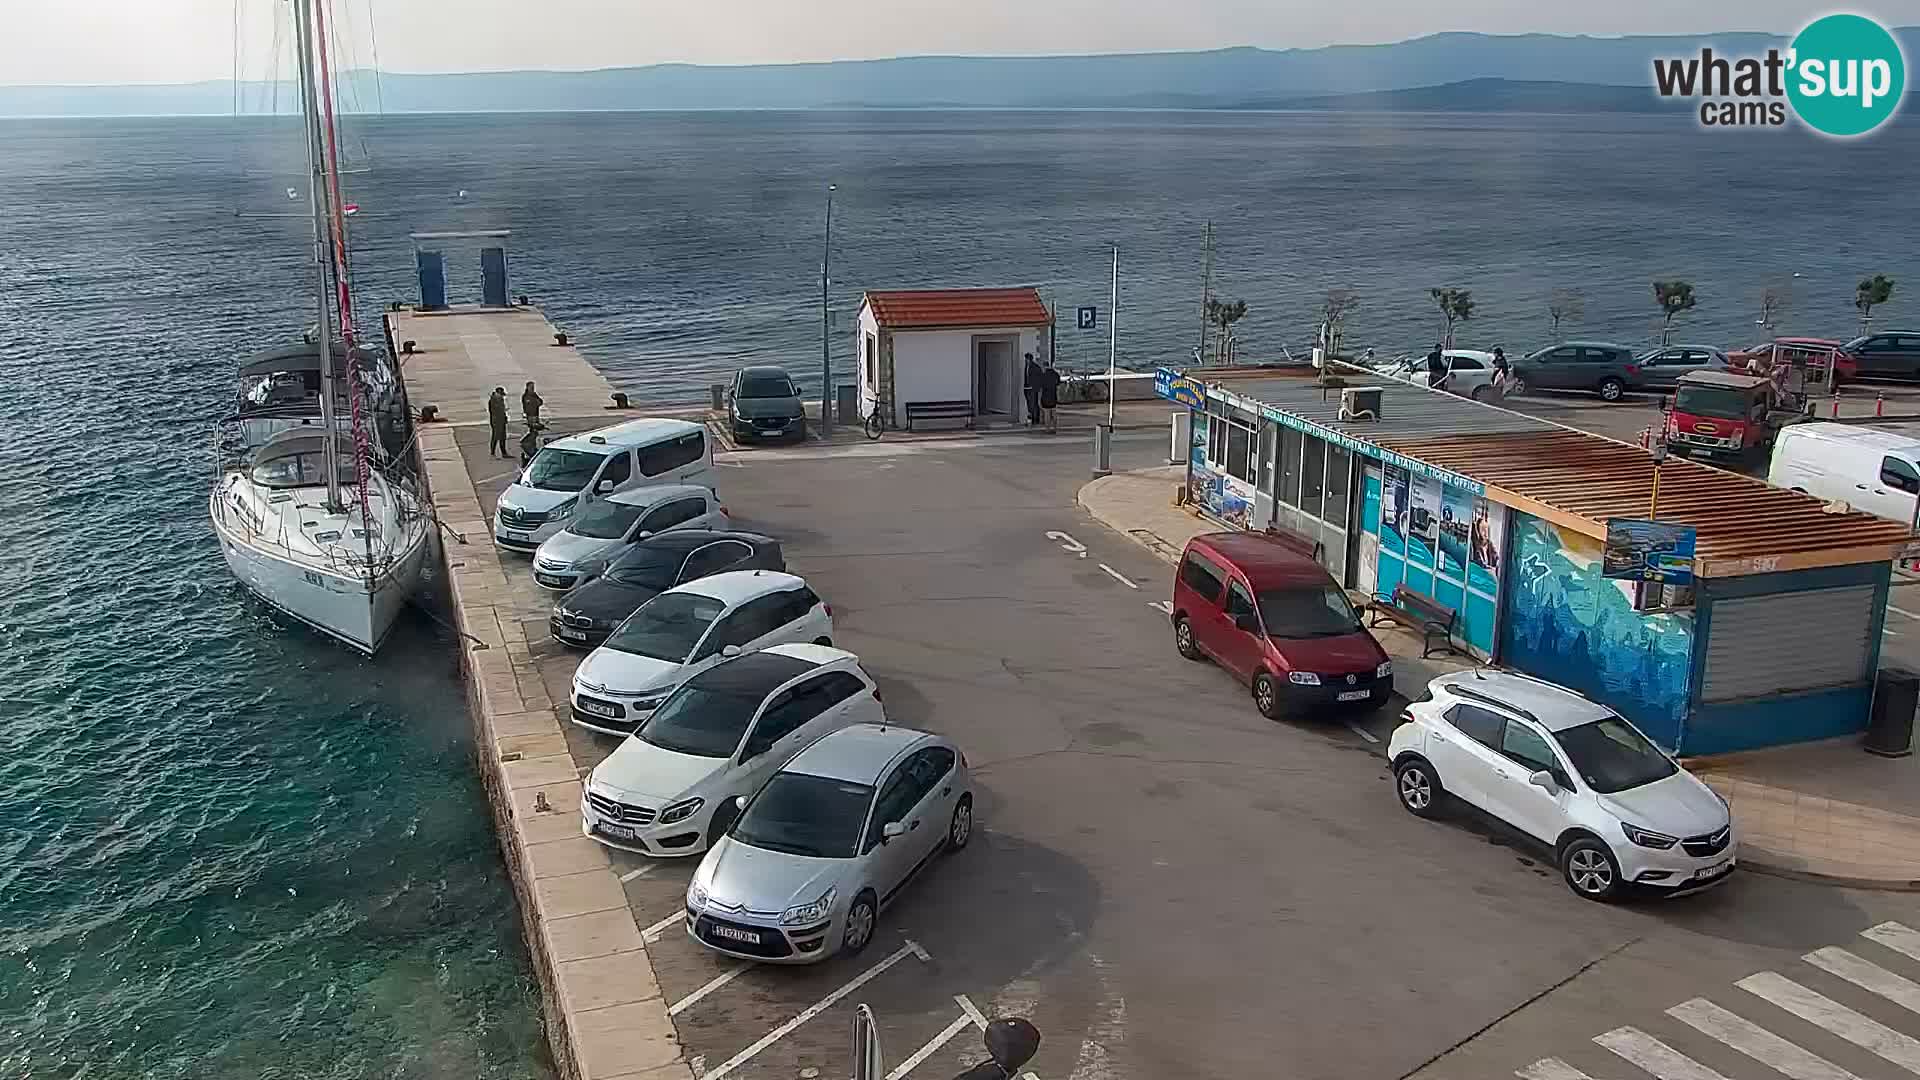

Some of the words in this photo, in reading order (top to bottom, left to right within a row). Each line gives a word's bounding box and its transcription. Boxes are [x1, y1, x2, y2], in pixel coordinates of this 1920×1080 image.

[1081, 310, 1092, 326] P
[1380, 448, 1393, 461] BUS
[1395, 456, 1426, 474] STATION
[1428, 467, 1453, 483] TICKET
[1454, 476, 1481, 492] OFFICE
